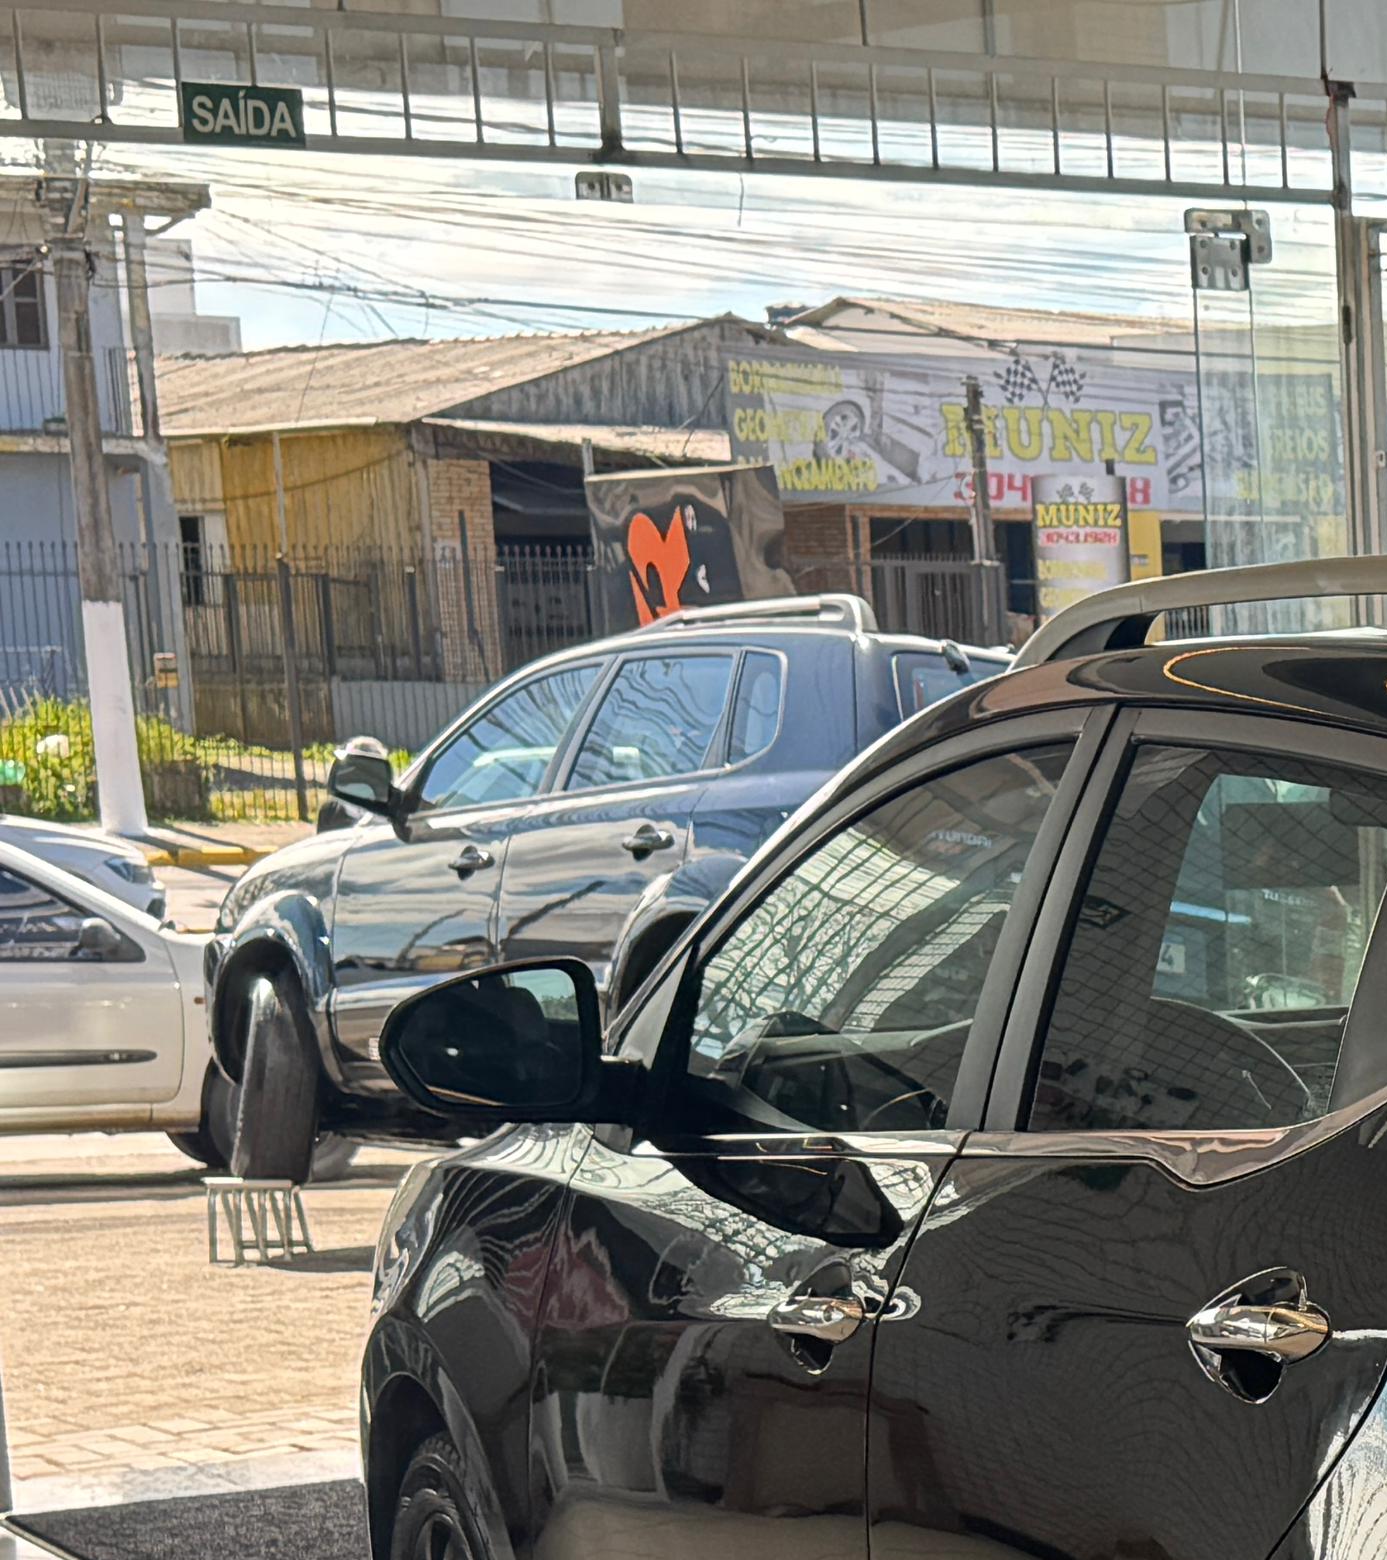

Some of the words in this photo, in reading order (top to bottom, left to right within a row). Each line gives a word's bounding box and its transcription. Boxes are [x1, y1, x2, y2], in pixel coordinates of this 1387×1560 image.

[191, 89, 297, 138] SAÍDA
[939, 402, 1158, 465] MUNIZ
[1035, 503, 1122, 528] MUNIZ
